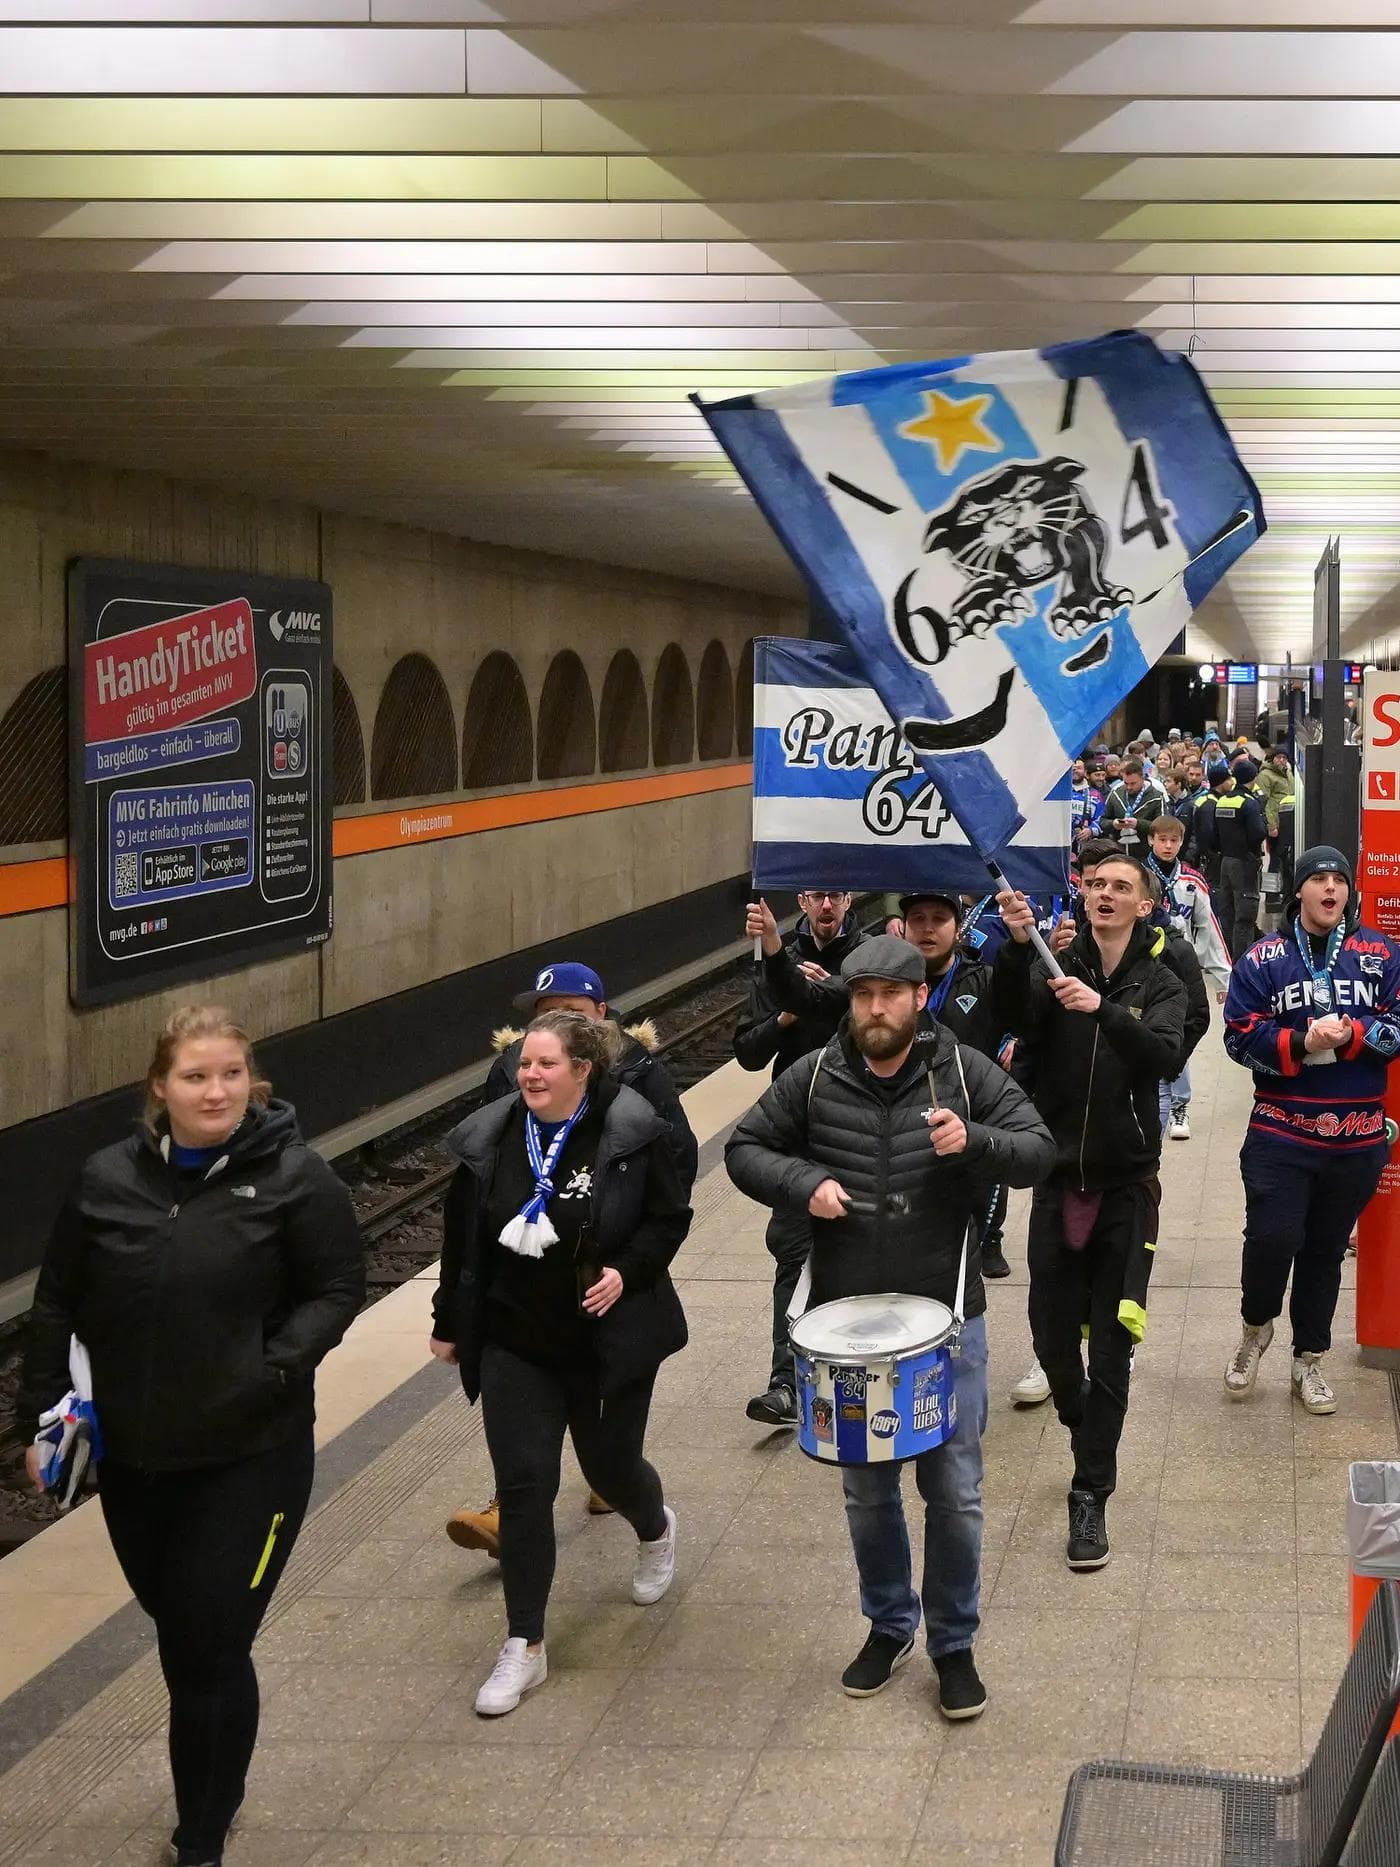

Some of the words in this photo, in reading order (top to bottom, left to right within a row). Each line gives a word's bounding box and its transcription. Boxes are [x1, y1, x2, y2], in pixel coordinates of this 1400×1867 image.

[285, 611, 321, 631] MVG
[95, 616, 248, 705] HandyTicket
[127, 703, 155, 733] gültig
[157, 698, 169, 716] im
[171, 682, 213, 716] gesamten
[214, 672, 233, 695] MVV
[97, 744, 149, 772] bargeldlos
[160, 734, 193, 757] einfach
[204, 727, 234, 748] überall
[116, 799, 146, 823] MVG
[149, 794, 200, 819] Fahrinfo
[202, 789, 250, 813] München
[863, 766, 951, 838] 64
[128, 828, 148, 847] Jetzt
[150, 824, 180, 841] einfach
[181, 821, 204, 841] gratis
[204, 815, 250, 834] downloaden!
[400, 814, 453, 838] Olympiazentrum
[155, 867, 173, 886] App
[173, 863, 194, 880] Store
[210, 857, 234, 874] Google
[1367, 866, 1390, 876] Gleis
[1392, 866, 1399, 876] 2
[109, 922, 138, 943] mvg.de
[828, 1364, 880, 1383] Panther
[843, 1381, 866, 1400] 64
[914, 1393, 940, 1415] BLAU
[871, 1414, 900, 1433] 1964
[914, 1407, 943, 1430] WEISS
